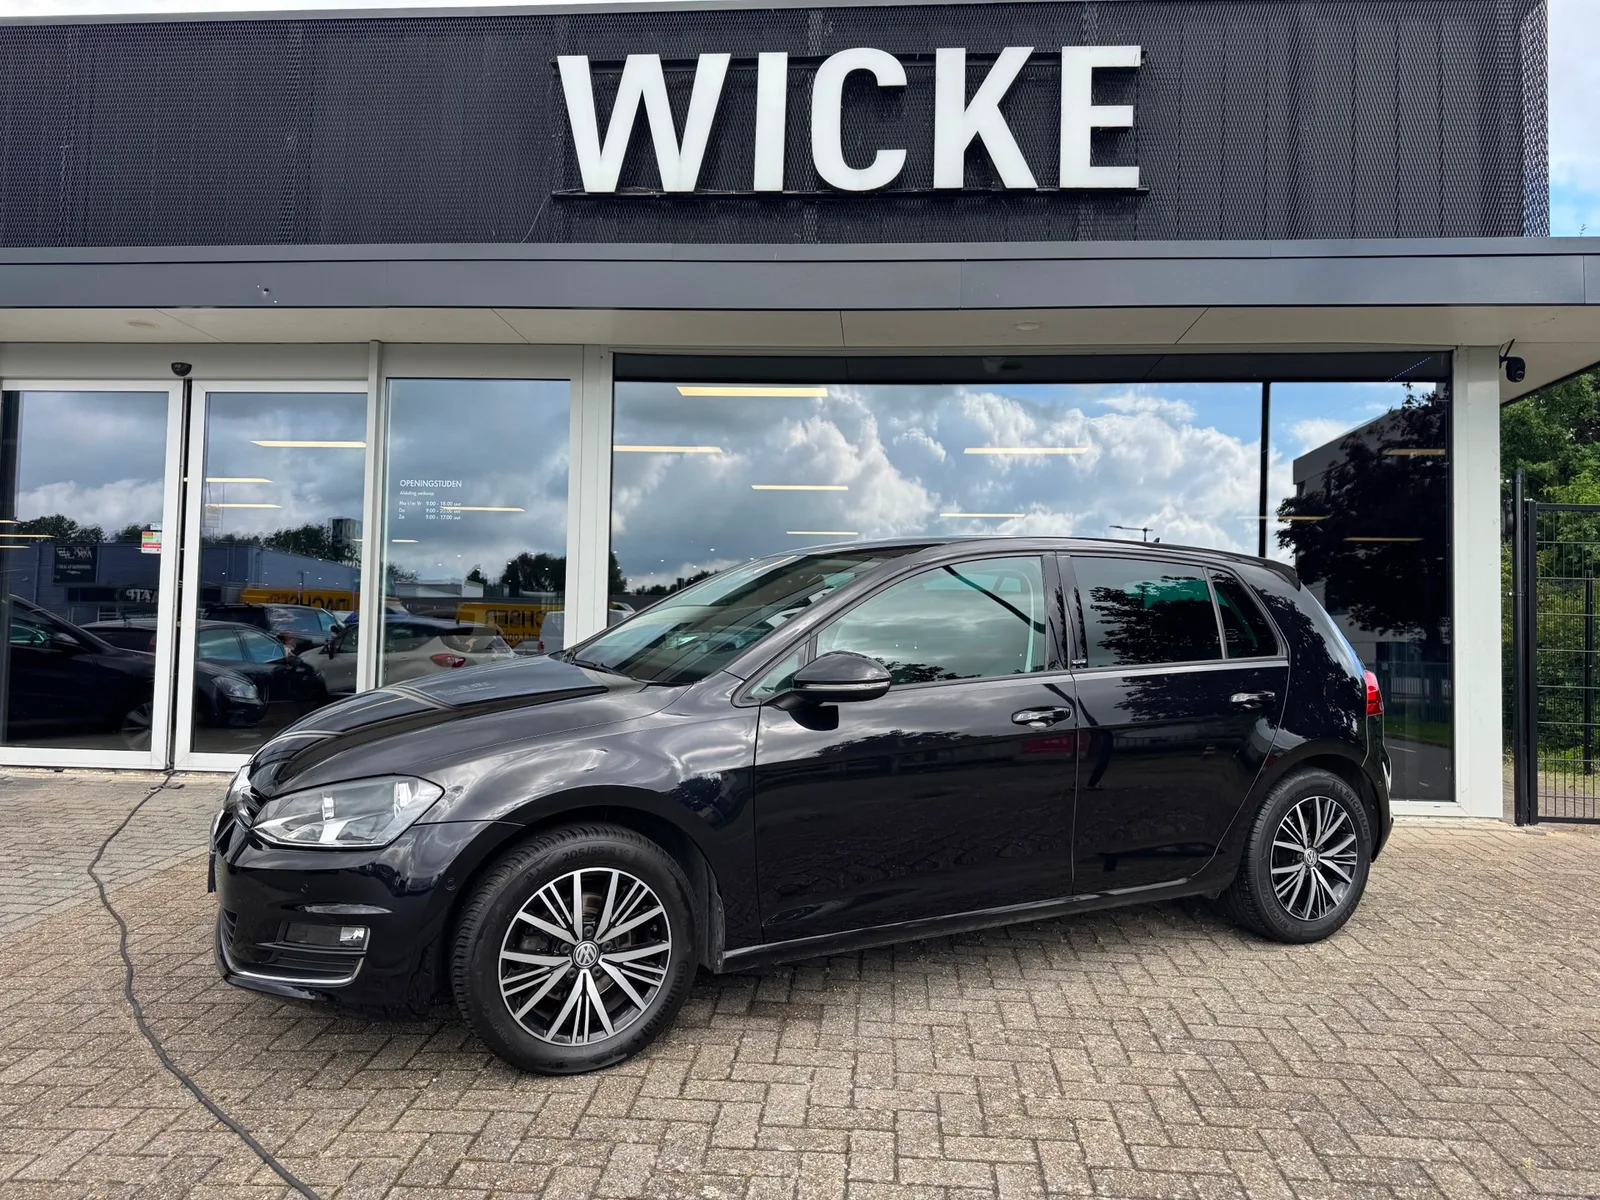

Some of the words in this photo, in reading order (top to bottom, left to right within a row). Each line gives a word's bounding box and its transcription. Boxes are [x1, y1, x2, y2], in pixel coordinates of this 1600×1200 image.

[557, 45, 1142, 193] WICKE
[399, 479, 463, 488] OPENINGSTIJDEN
[562, 846, 605, 862] 205/55
